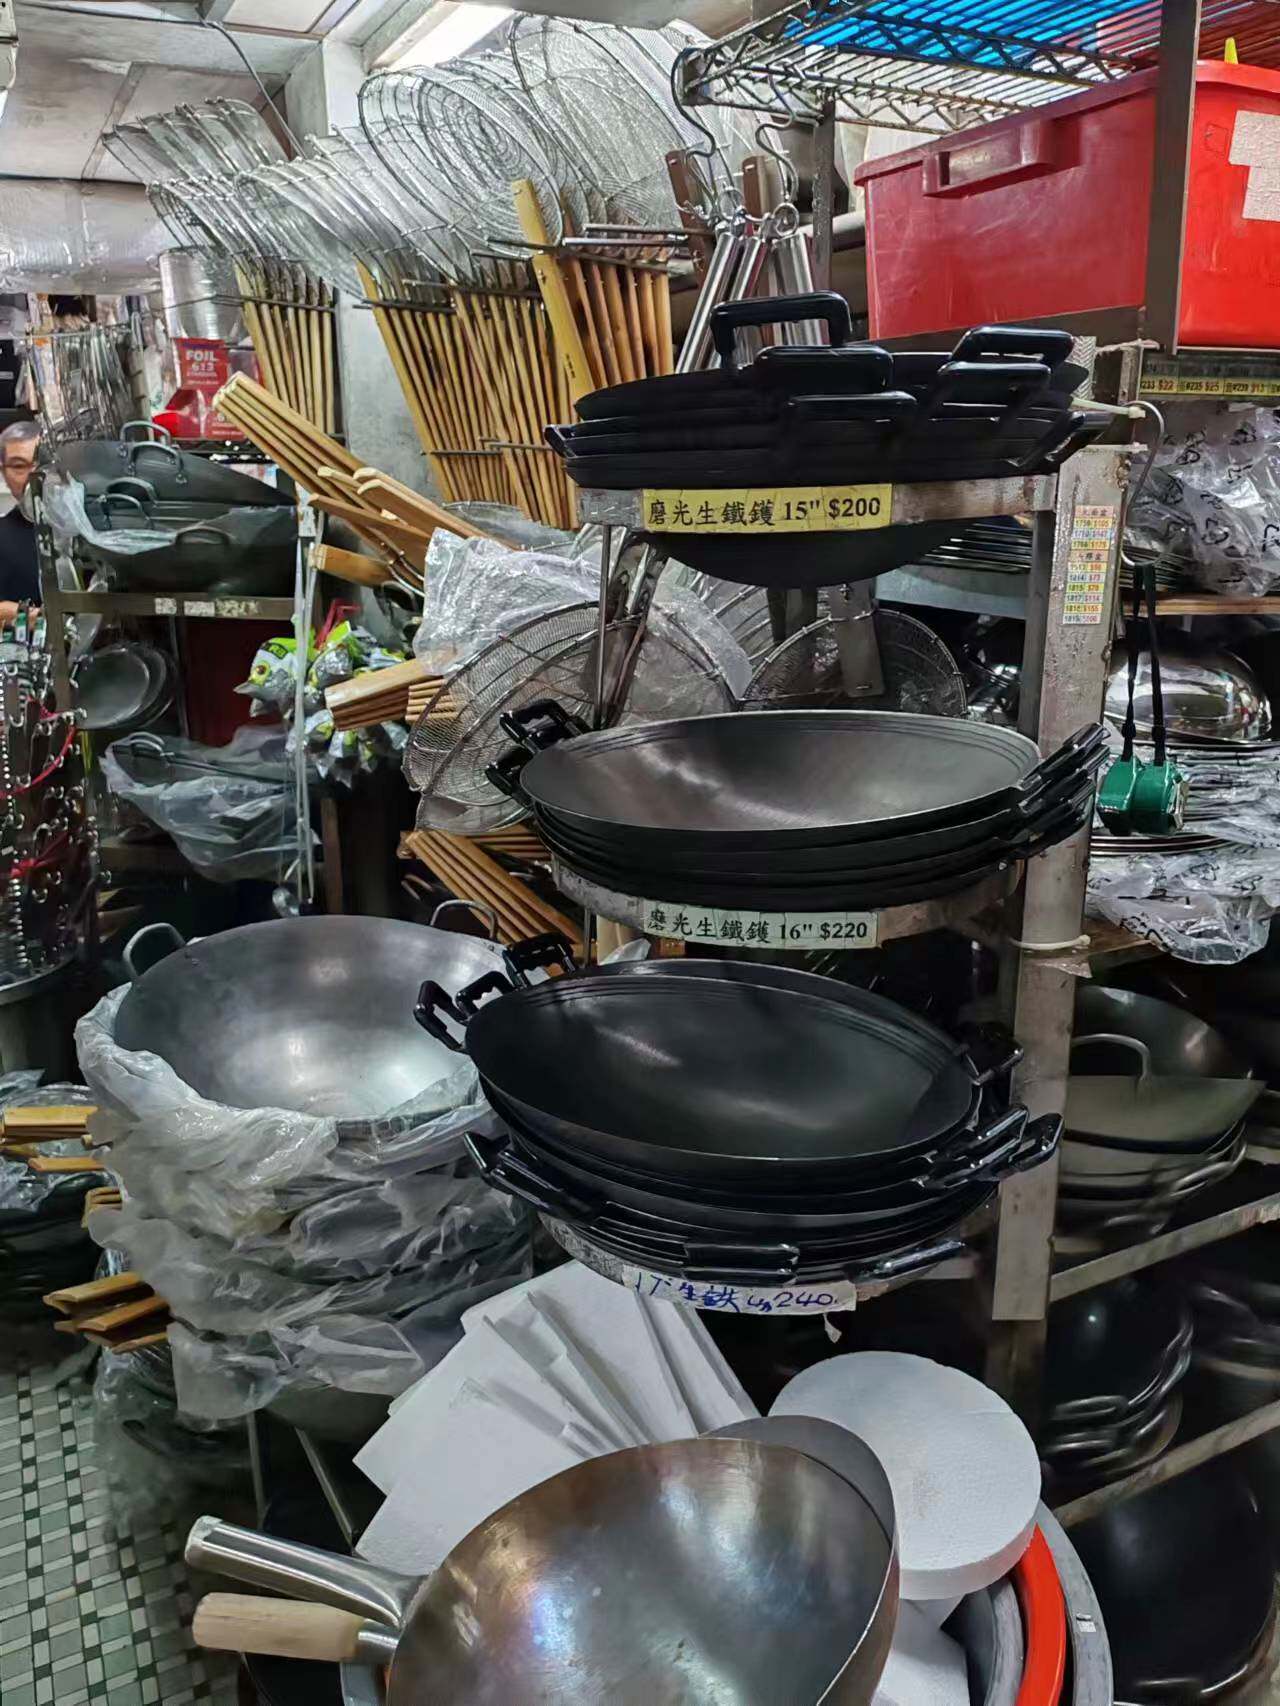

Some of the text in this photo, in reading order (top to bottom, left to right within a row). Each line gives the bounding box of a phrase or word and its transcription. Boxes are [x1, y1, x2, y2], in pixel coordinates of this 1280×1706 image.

[186, 350, 219, 361] FOIL
[649, 498, 881, 527] 磨光生鐵鑊 15" $200
[648, 909, 868, 944] 磨光生鐵鑊 16" $220
